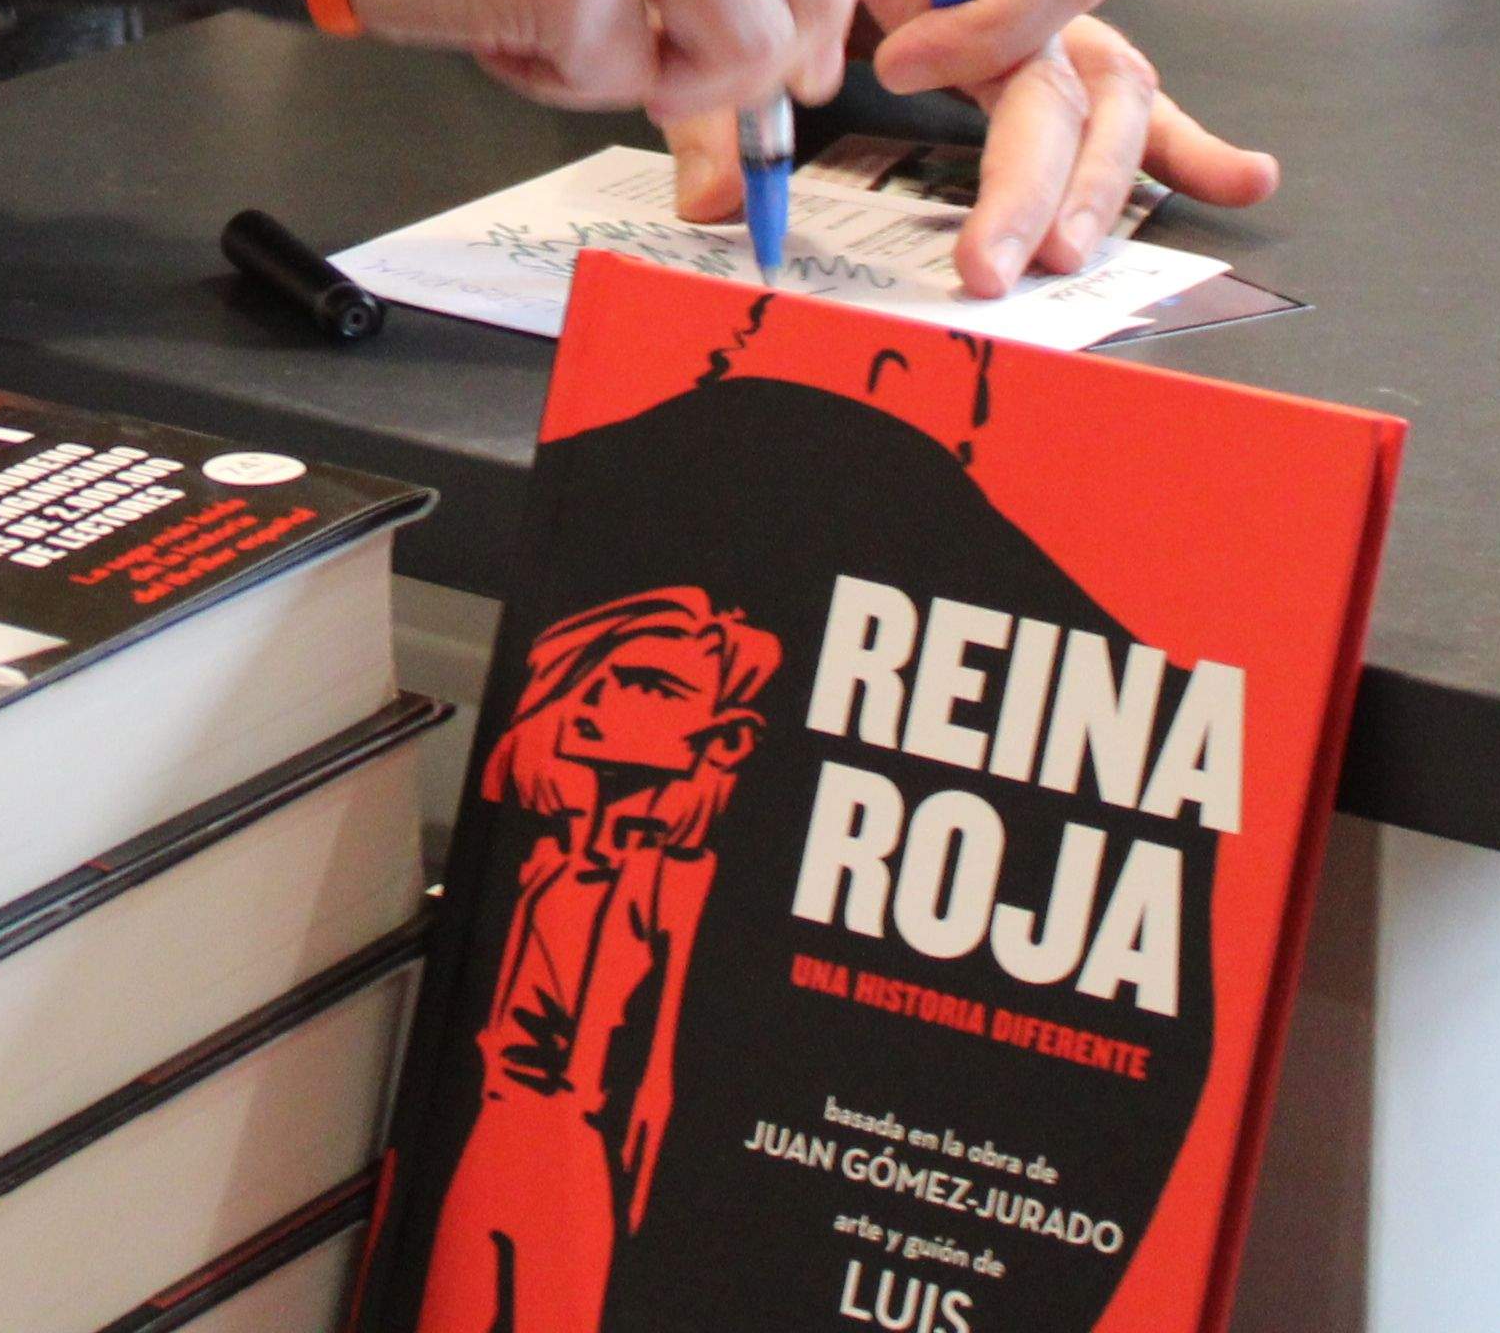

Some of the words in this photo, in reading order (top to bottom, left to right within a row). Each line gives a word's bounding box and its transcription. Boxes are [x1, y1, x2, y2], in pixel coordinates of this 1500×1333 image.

[4, 516, 64, 539] DE
[42, 457, 185, 522] 2.000.000
[9, 544, 68, 568] DE
[46, 485, 186, 550] LECTORES
[806, 574, 1247, 835] REINA
[791, 760, 1183, 1018] ROJA
[790, 953, 850, 999] UNA
[852, 972, 987, 1036] HISTORIA
[991, 1007, 1153, 1081] DIFERENTE
[823, 1095, 906, 1141] basada
[907, 1129, 939, 1152] en
[940, 1129, 966, 1159] la
[968, 1142, 1024, 1177] obra
[1025, 1154, 1060, 1186] de
[744, 1120, 836, 1172] JUAN
[841, 1143, 1126, 1255] GÓMEZ-JURADO
[833, 1210, 884, 1244] arte
[884, 1229, 903, 1253] y
[902, 1234, 971, 1272] guión
[972, 1243, 1008, 1279] de
[837, 1259, 975, 1333] LUIS
